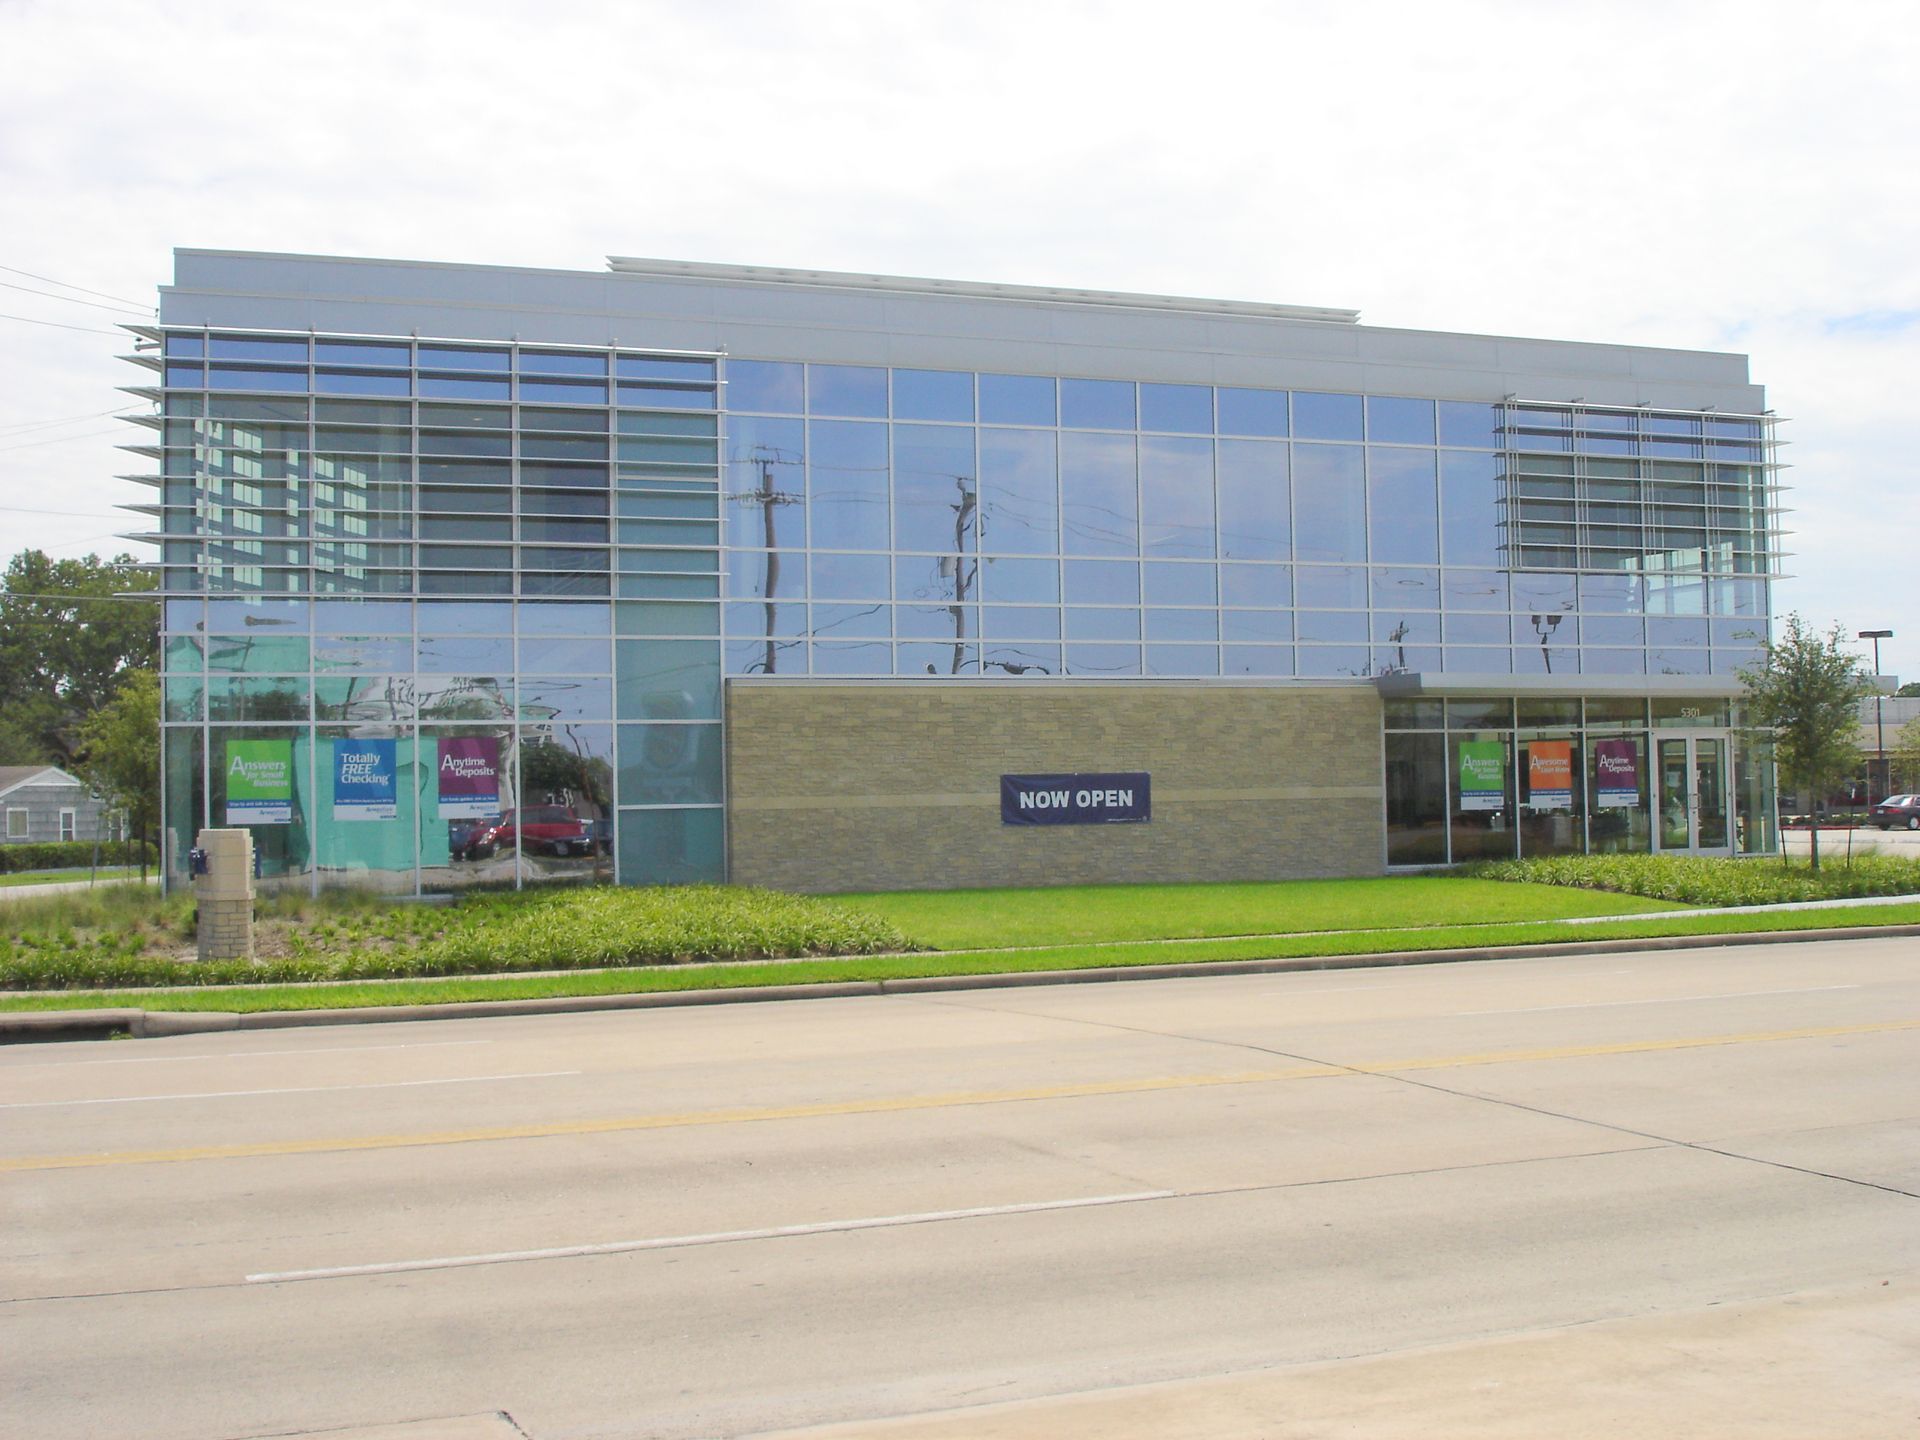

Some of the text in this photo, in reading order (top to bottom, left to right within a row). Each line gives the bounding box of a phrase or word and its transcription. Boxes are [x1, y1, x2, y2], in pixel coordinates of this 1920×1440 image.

[1681, 707, 1700, 718] 5301
[229, 755, 287, 776] Answers
[341, 753, 381, 766] Totally
[441, 754, 486, 771] Anytime
[1462, 754, 1500, 770] Answers
[1530, 755, 1568, 770] Awesome
[1599, 754, 1629, 769] Anytime
[342, 764, 373, 774] FREE
[456, 767, 495, 778] Deposits
[1608, 765, 1635, 774] Deposits
[246, 771, 285, 780] for Small
[341, 774, 390, 786] Checking
[253, 779, 288, 787] Business
[1020, 789, 1133, 809] NOW OPEN
